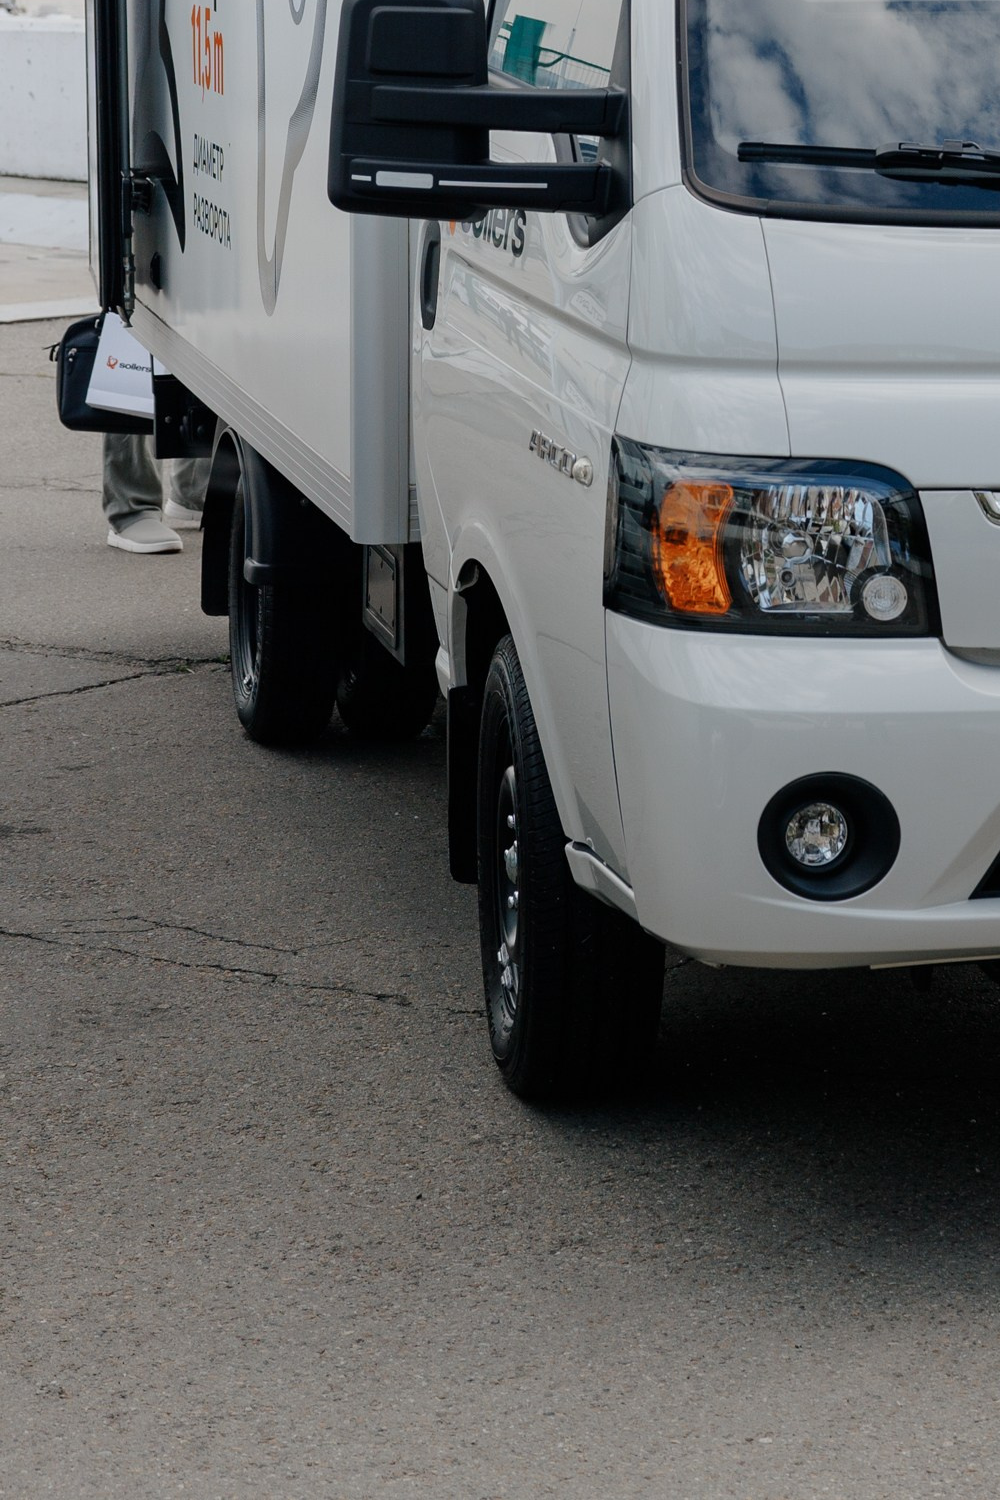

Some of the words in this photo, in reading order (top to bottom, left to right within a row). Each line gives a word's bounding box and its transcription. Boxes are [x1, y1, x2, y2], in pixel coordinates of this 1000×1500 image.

[191, 3, 211, 103] 11,5
[193, 132, 225, 182] ДИАМЕТР
[193, 192, 232, 250] РАЗВОРОТА
[461, 209, 527, 258] lers
[119, 362, 152, 373] sollers
